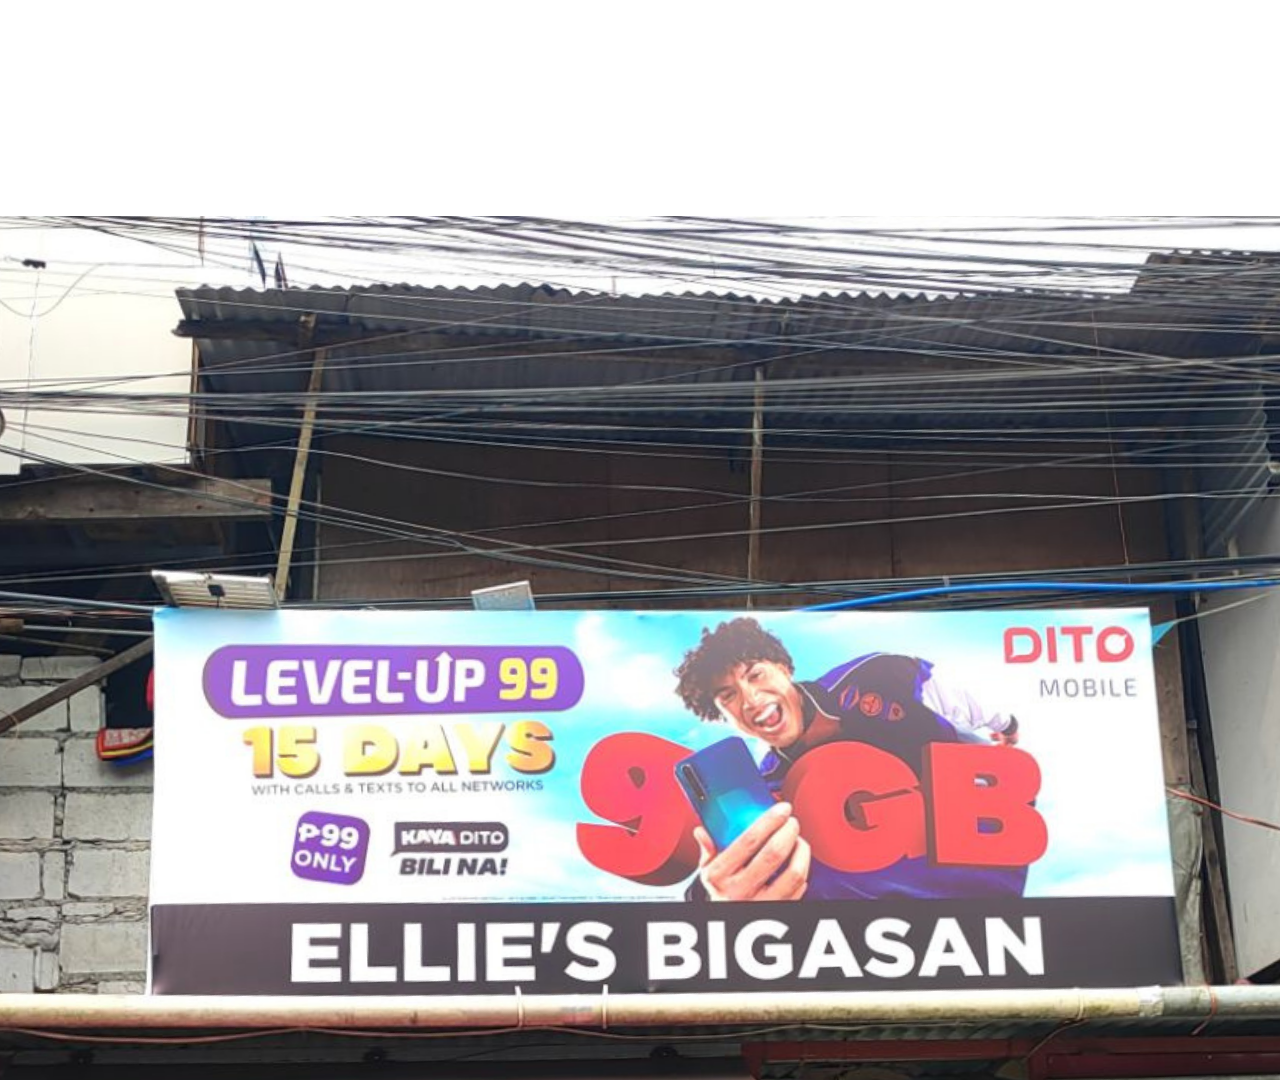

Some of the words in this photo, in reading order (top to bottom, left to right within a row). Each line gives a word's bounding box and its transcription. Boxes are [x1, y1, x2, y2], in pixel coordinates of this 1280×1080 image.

[1004, 626, 1135, 663] DITO
[230, 652, 486, 706] LEVEL-UP
[499, 657, 558, 700] 99
[1039, 678, 1138, 698] MOBILE
[242, 725, 322, 779] 15
[342, 720, 557, 777] DAYS
[251, 784, 290, 796] WITH
[294, 783, 341, 795] CALLS
[344, 783, 353, 794] &
[358, 782, 403, 794] TEXTS
[407, 782, 427, 794] TO
[430, 781, 458, 793] ALL
[461, 779, 545, 792] NETWORKS
[780, 740, 1049, 873] GB
[401, 828, 456, 846] KAYA
[459, 830, 505, 845] DITO
[294, 849, 358, 873] ONLY
[399, 857, 452, 876] BILI
[456, 857, 509, 876] NA!
[290, 921, 616, 984] ELLIE'S
[646, 917, 1045, 981] BIGASAN
